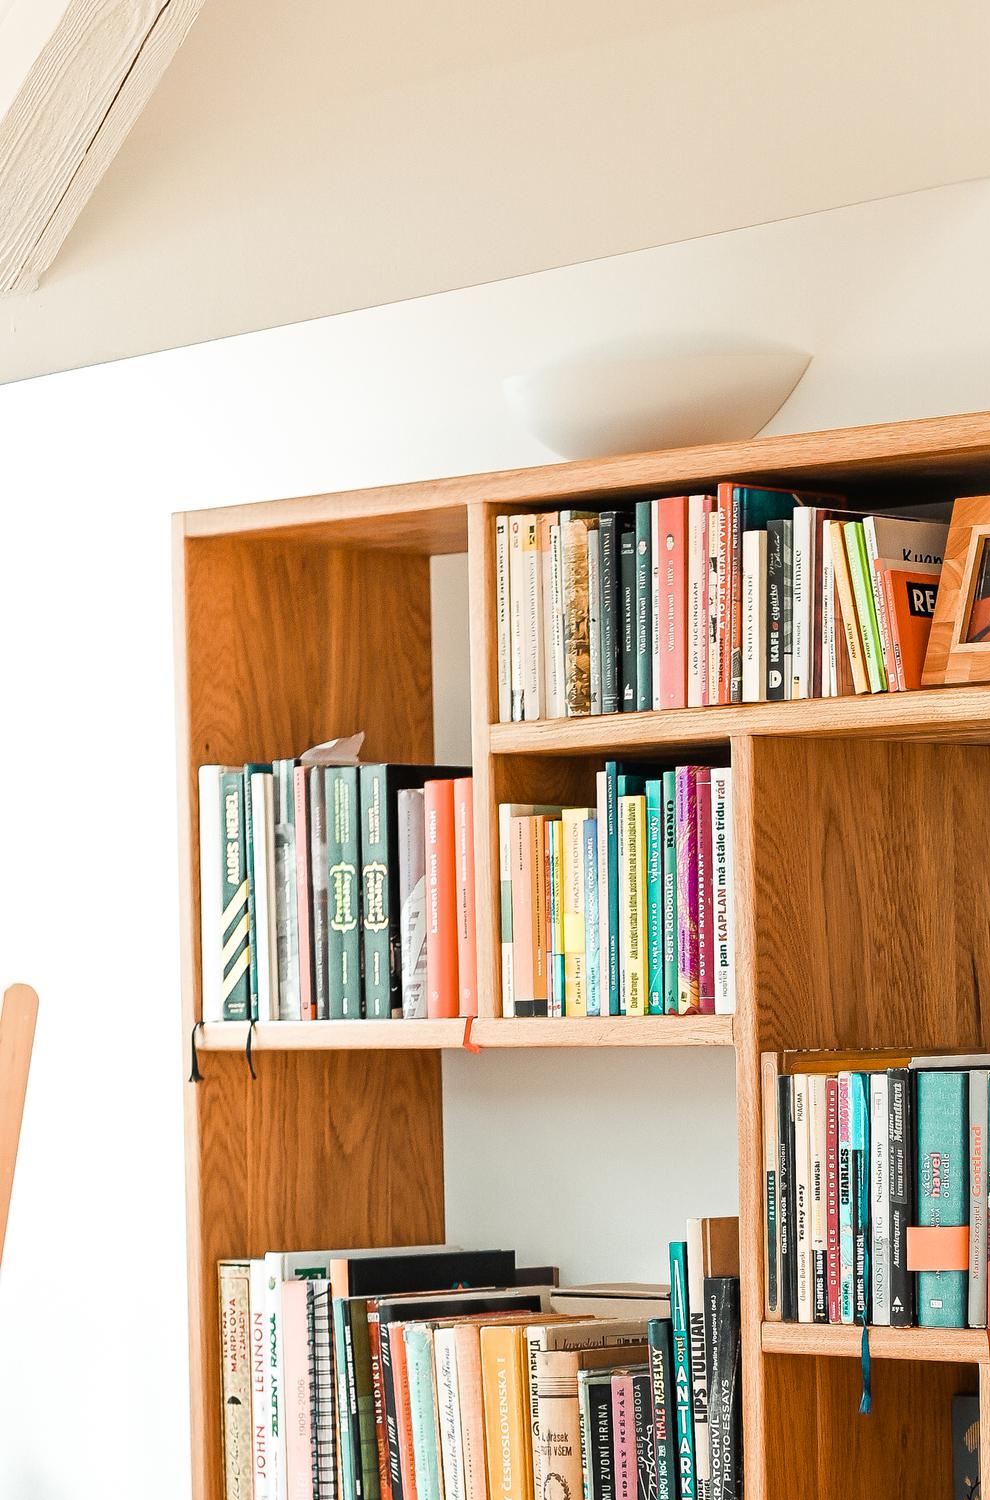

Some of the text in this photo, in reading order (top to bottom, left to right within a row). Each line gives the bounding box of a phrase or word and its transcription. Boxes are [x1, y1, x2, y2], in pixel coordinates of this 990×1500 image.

[793, 550, 802, 602] afirmace
[771, 632, 779, 662] KAFE
[225, 791, 240, 885] ALOIS NEBEL
[715, 780, 730, 967] pan KAPLAN má stále třídu rád
[923, 1153, 931, 1197] václav
[930, 1153, 941, 1198] havel
[972, 1125, 982, 1197] Gottland
[972, 1246, 981, 1279] Mariusz
[254, 1312, 264, 1392] LENNON
[690, 1312, 708, 1424] LIPS TULLIAN
[497, 1369, 513, 1491] ČESKOSLOVENSKA
[596, 1404, 609, 1441] HRANA
[256, 1426, 266, 1478] JOHN
[597, 1444, 610, 1480] ZVONÍ
[722, 1436, 731, 1482] PHOTO
